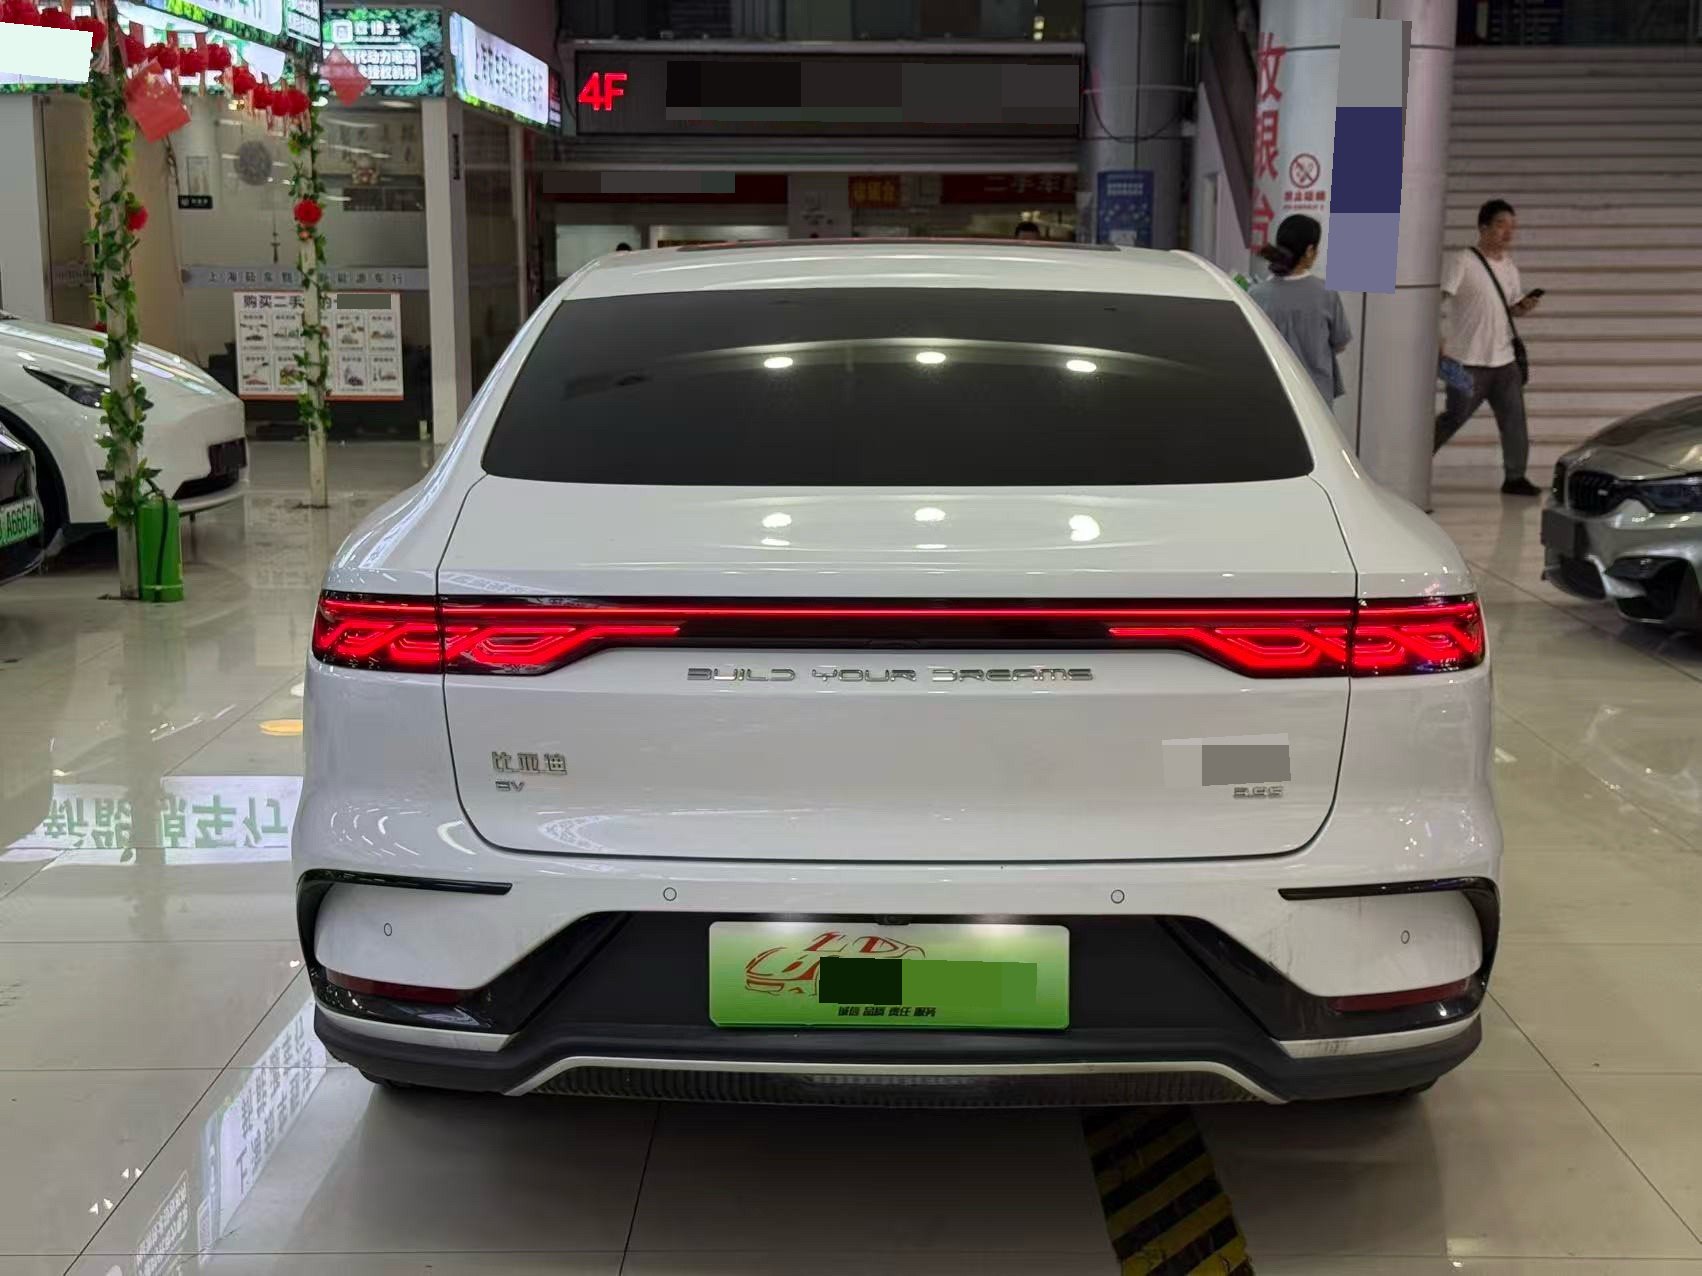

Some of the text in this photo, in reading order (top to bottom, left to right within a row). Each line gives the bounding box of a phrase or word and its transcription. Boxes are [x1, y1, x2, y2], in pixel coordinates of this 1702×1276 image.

[577, 71, 628, 111] 4F
[243, 295, 332, 310] 购买二手的
[687, 667, 1094, 682] BUILD YOUR DREAMS
[491, 751, 568, 776] 比亚迪
